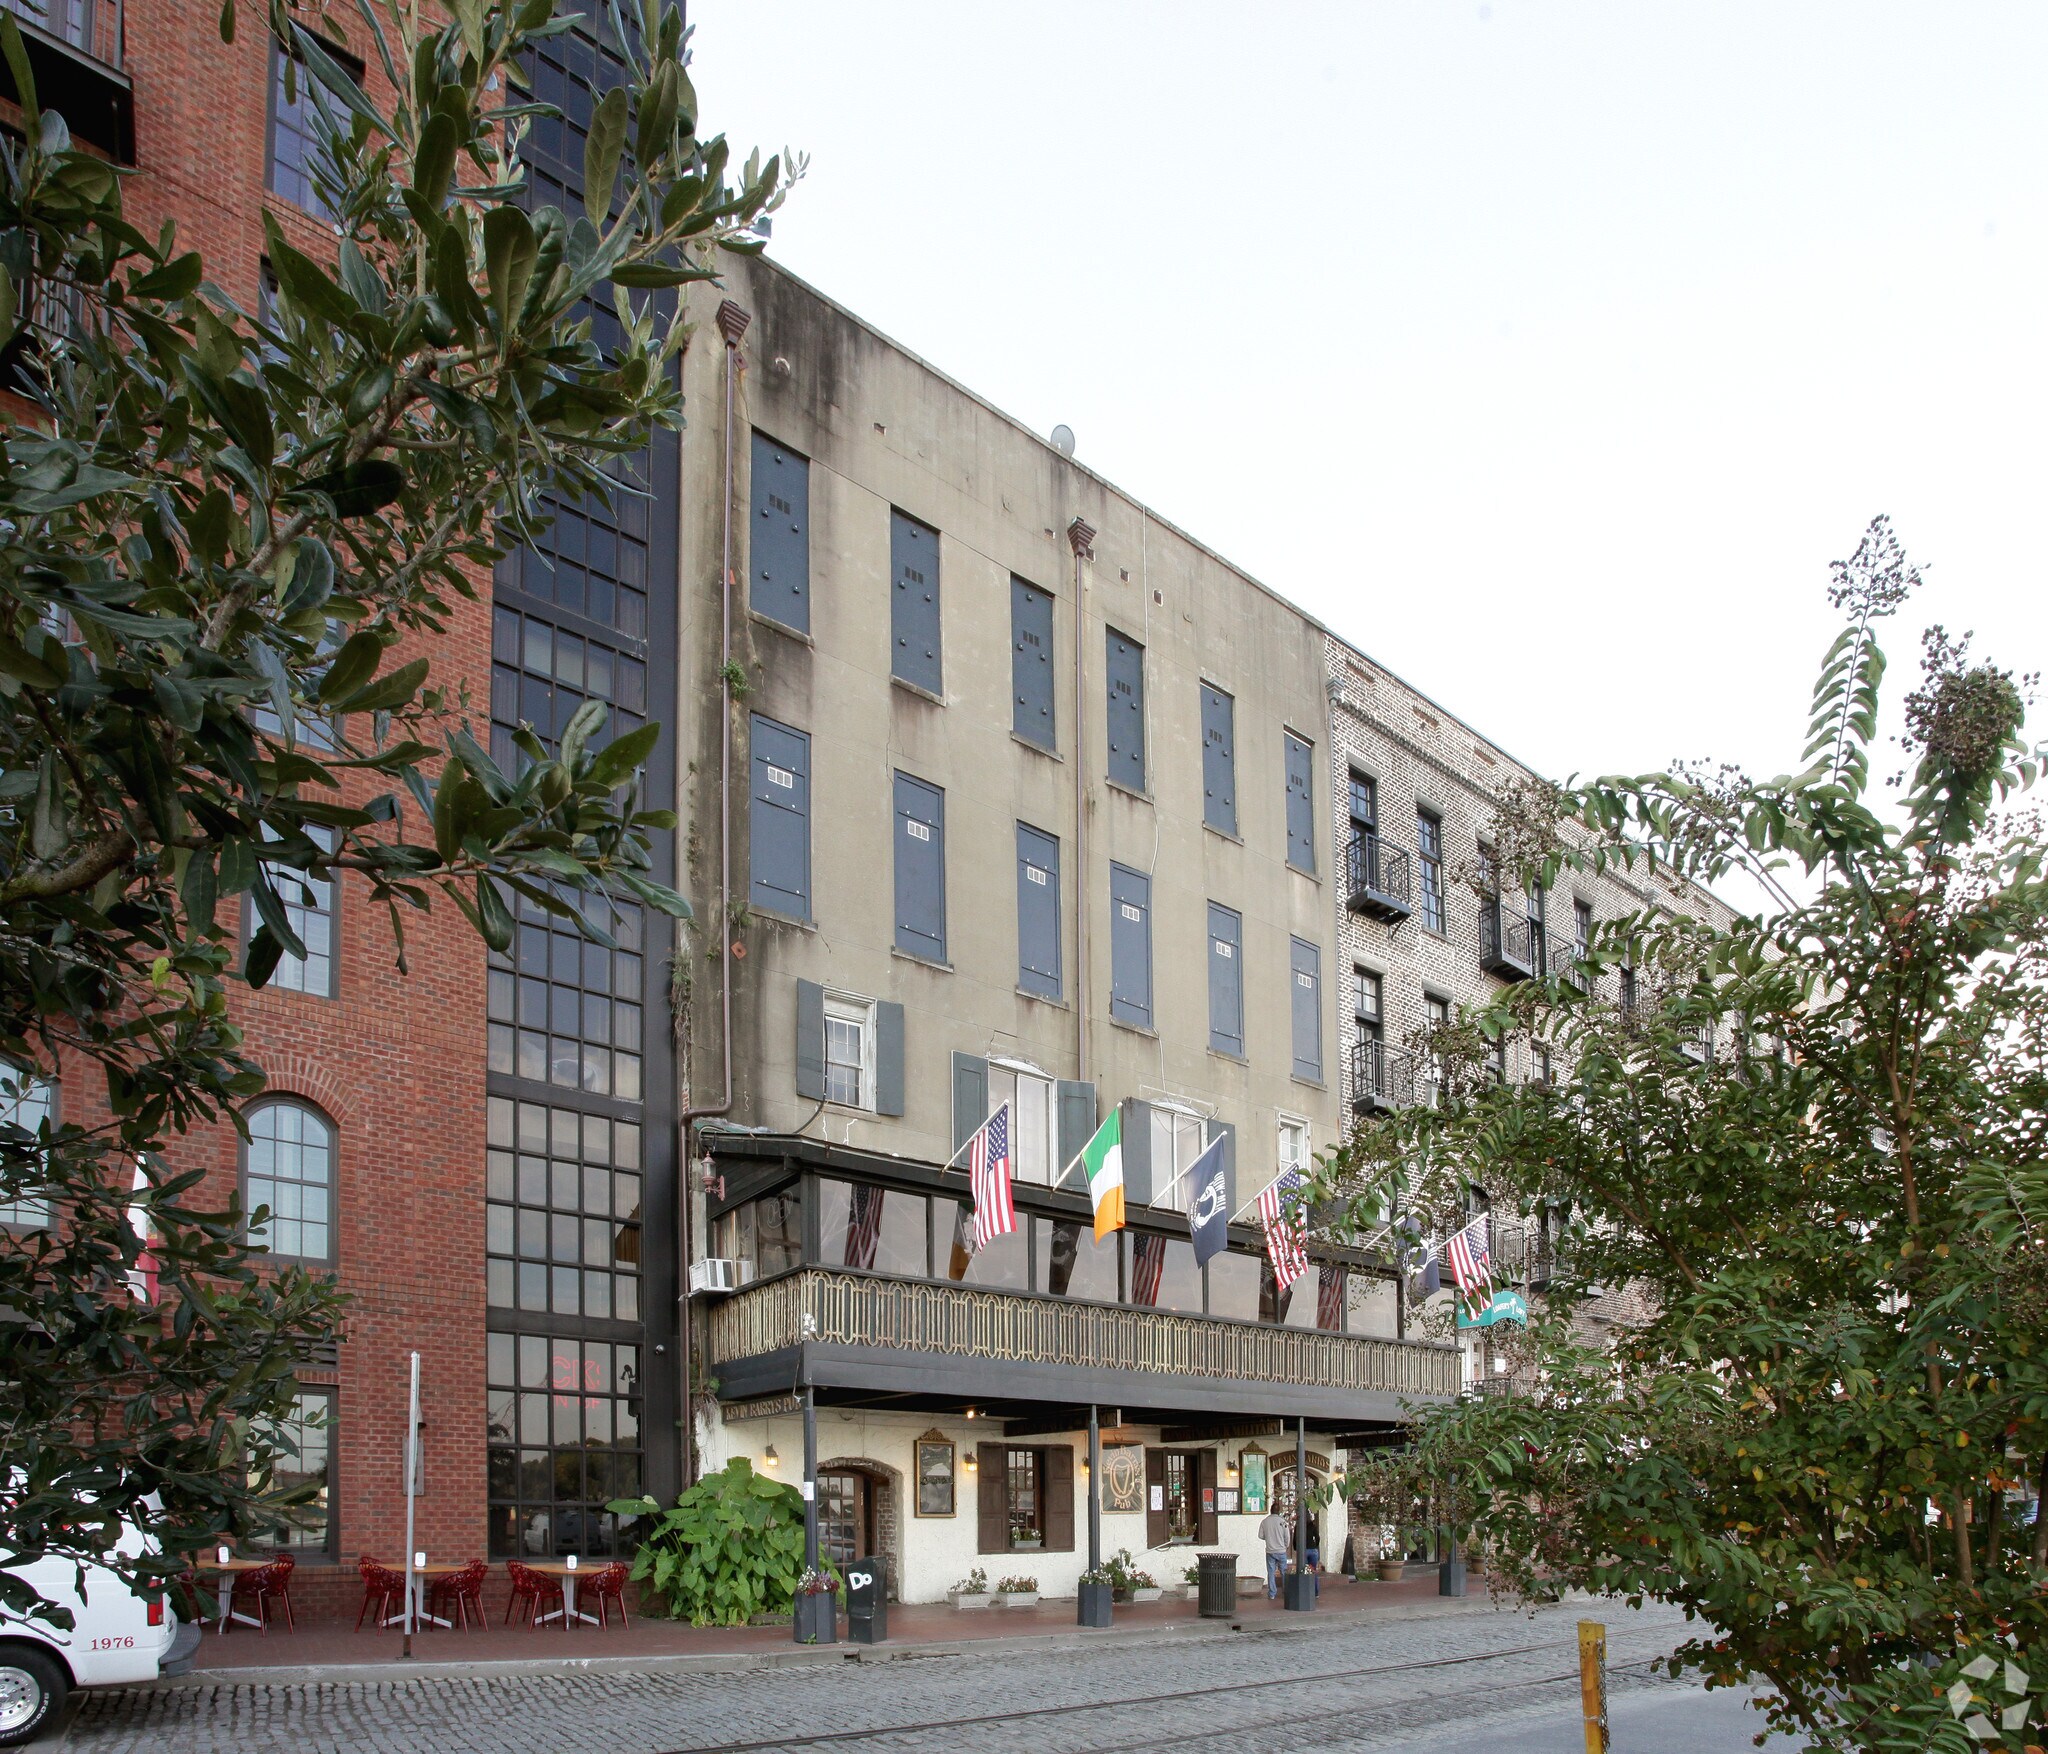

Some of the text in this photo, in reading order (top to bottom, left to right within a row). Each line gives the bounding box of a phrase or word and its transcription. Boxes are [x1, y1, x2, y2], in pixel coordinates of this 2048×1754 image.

[726, 1404, 748, 1421] KEVIN
[783, 1396, 802, 1413] PUB
[1232, 1421, 1279, 1437] MILITARY
[1306, 1453, 1330, 1469] ARRYS
[1113, 1497, 1131, 1509] Pub
[848, 1568, 873, 1590] Do
[91, 1636, 134, 1651] 1976
